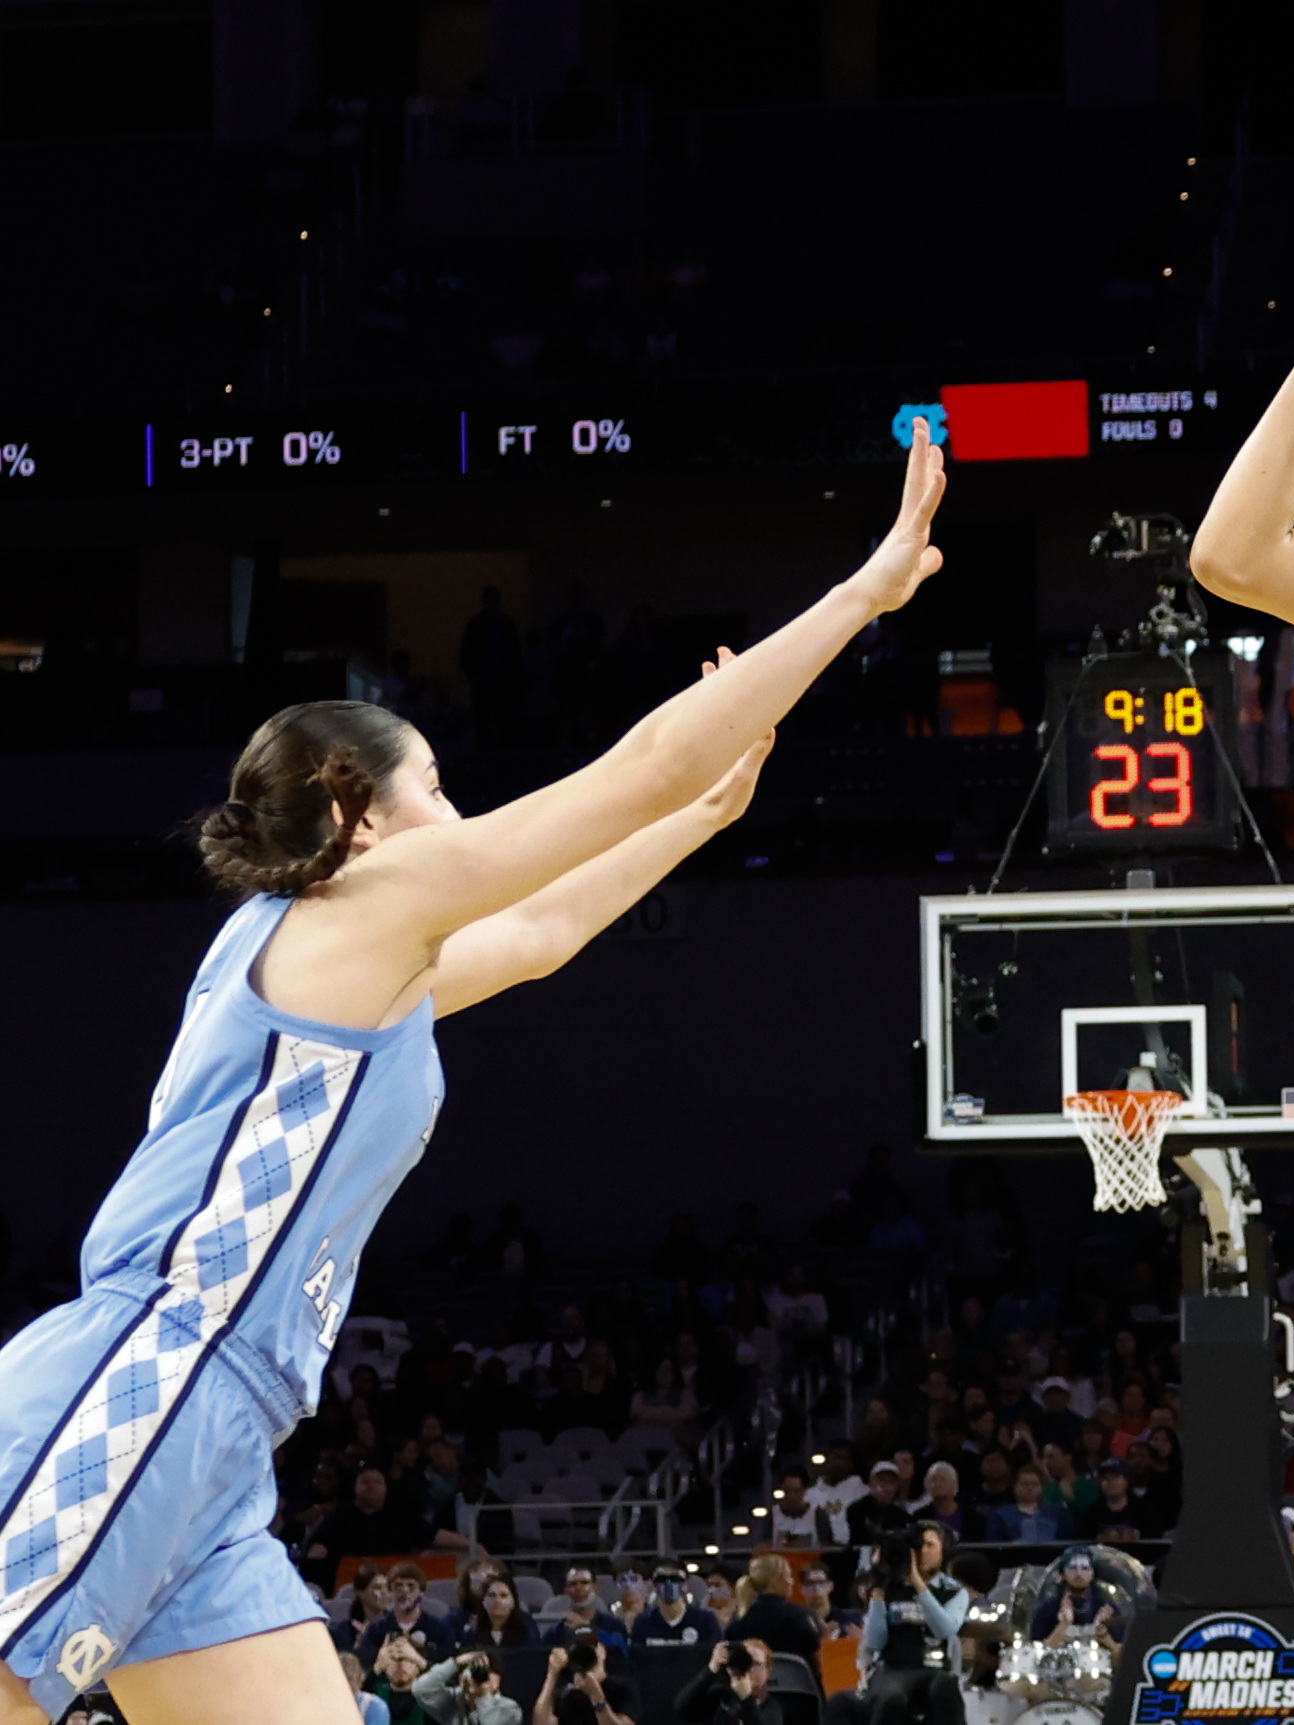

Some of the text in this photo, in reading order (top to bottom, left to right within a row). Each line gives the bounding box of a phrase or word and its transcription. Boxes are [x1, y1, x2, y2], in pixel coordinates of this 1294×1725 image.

[1099, 390, 1219, 413] TIMEOUTS 4
[499, 419, 632, 455] FT 0%
[1101, 419, 1184, 441] FOULS 0
[180, 431, 341, 468] 3-PT 0%
[1103, 687, 1205, 736] 9:18
[1090, 741, 1194, 830] 23
[1175, 1650, 1275, 1681] MARCH
